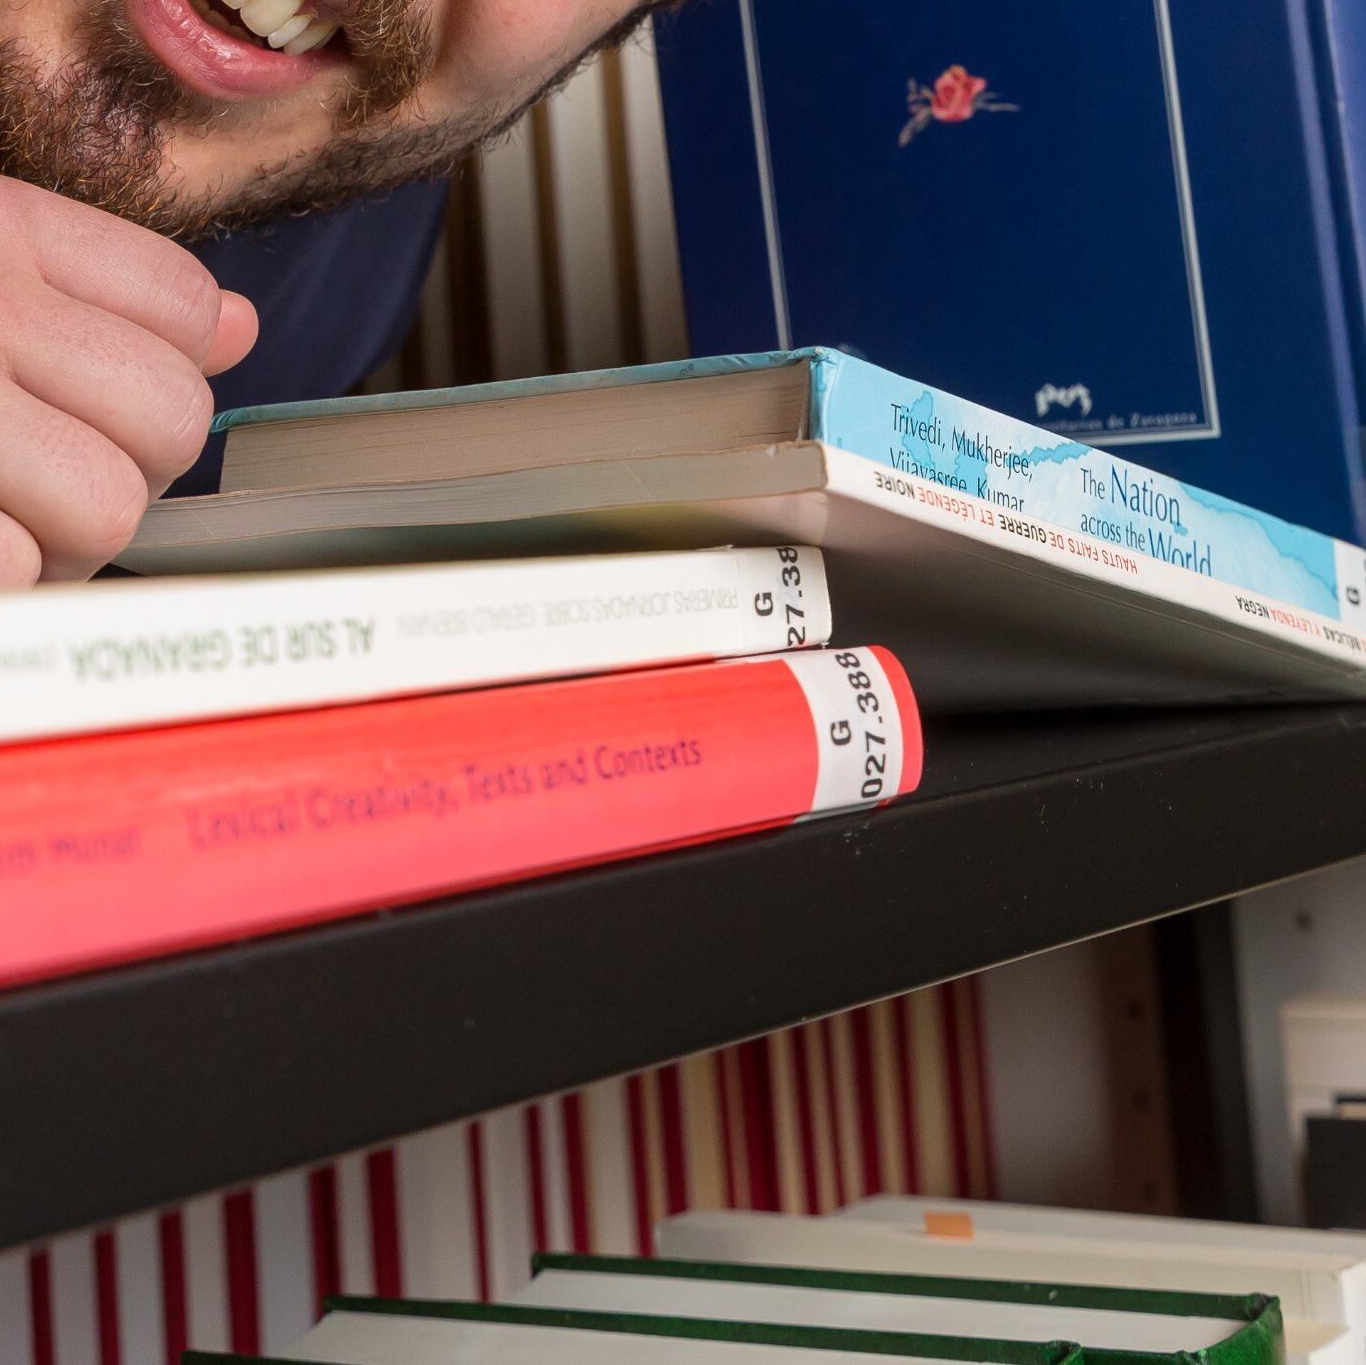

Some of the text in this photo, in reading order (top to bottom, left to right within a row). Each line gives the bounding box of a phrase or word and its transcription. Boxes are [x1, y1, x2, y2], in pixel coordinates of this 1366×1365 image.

[891, 403, 1033, 482] Trivedi, Mukherjee,
[1080, 463, 1181, 527] The Nation
[874, 471, 1138, 575] HAUTS FAITS DE GUERRE ET LÉGENDE NOIRE
[1080, 513, 1213, 577] across the World
[754, 591, 773, 616] G
[1235, 595, 1271, 620] NEGRA
[1346, 585, 1361, 606] G
[285, 619, 335, 662] SUR
[343, 616, 376, 656] AL
[1269, 608, 1314, 634] LEYENDA
[65, 627, 233, 682] GRANADA
[240, 623, 279, 668] DE
[830, 720, 852, 747] G
[836, 652, 886, 799] 027.388
[461, 763, 534, 802] Texts
[539, 747, 588, 790] and
[593, 738, 704, 780] Contexts
